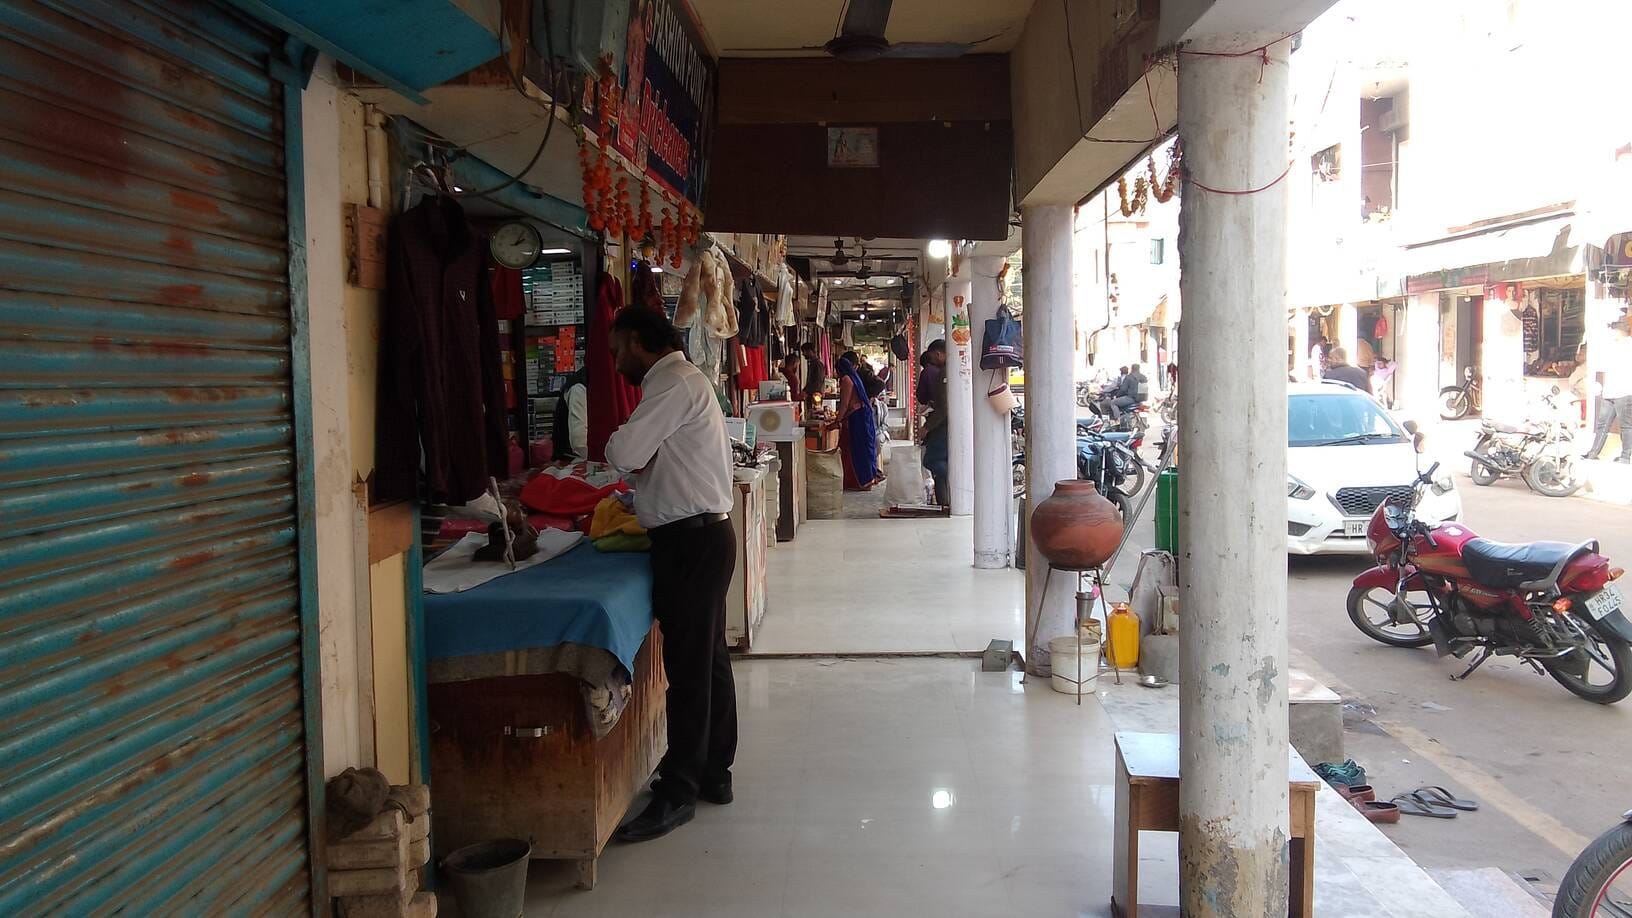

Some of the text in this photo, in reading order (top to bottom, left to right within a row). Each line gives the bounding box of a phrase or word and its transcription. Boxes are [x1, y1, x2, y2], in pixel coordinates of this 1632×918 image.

[652, 0, 688, 87] FASHION
[685, 42, 707, 113] POINT
[1352, 523, 1363, 534] HR
